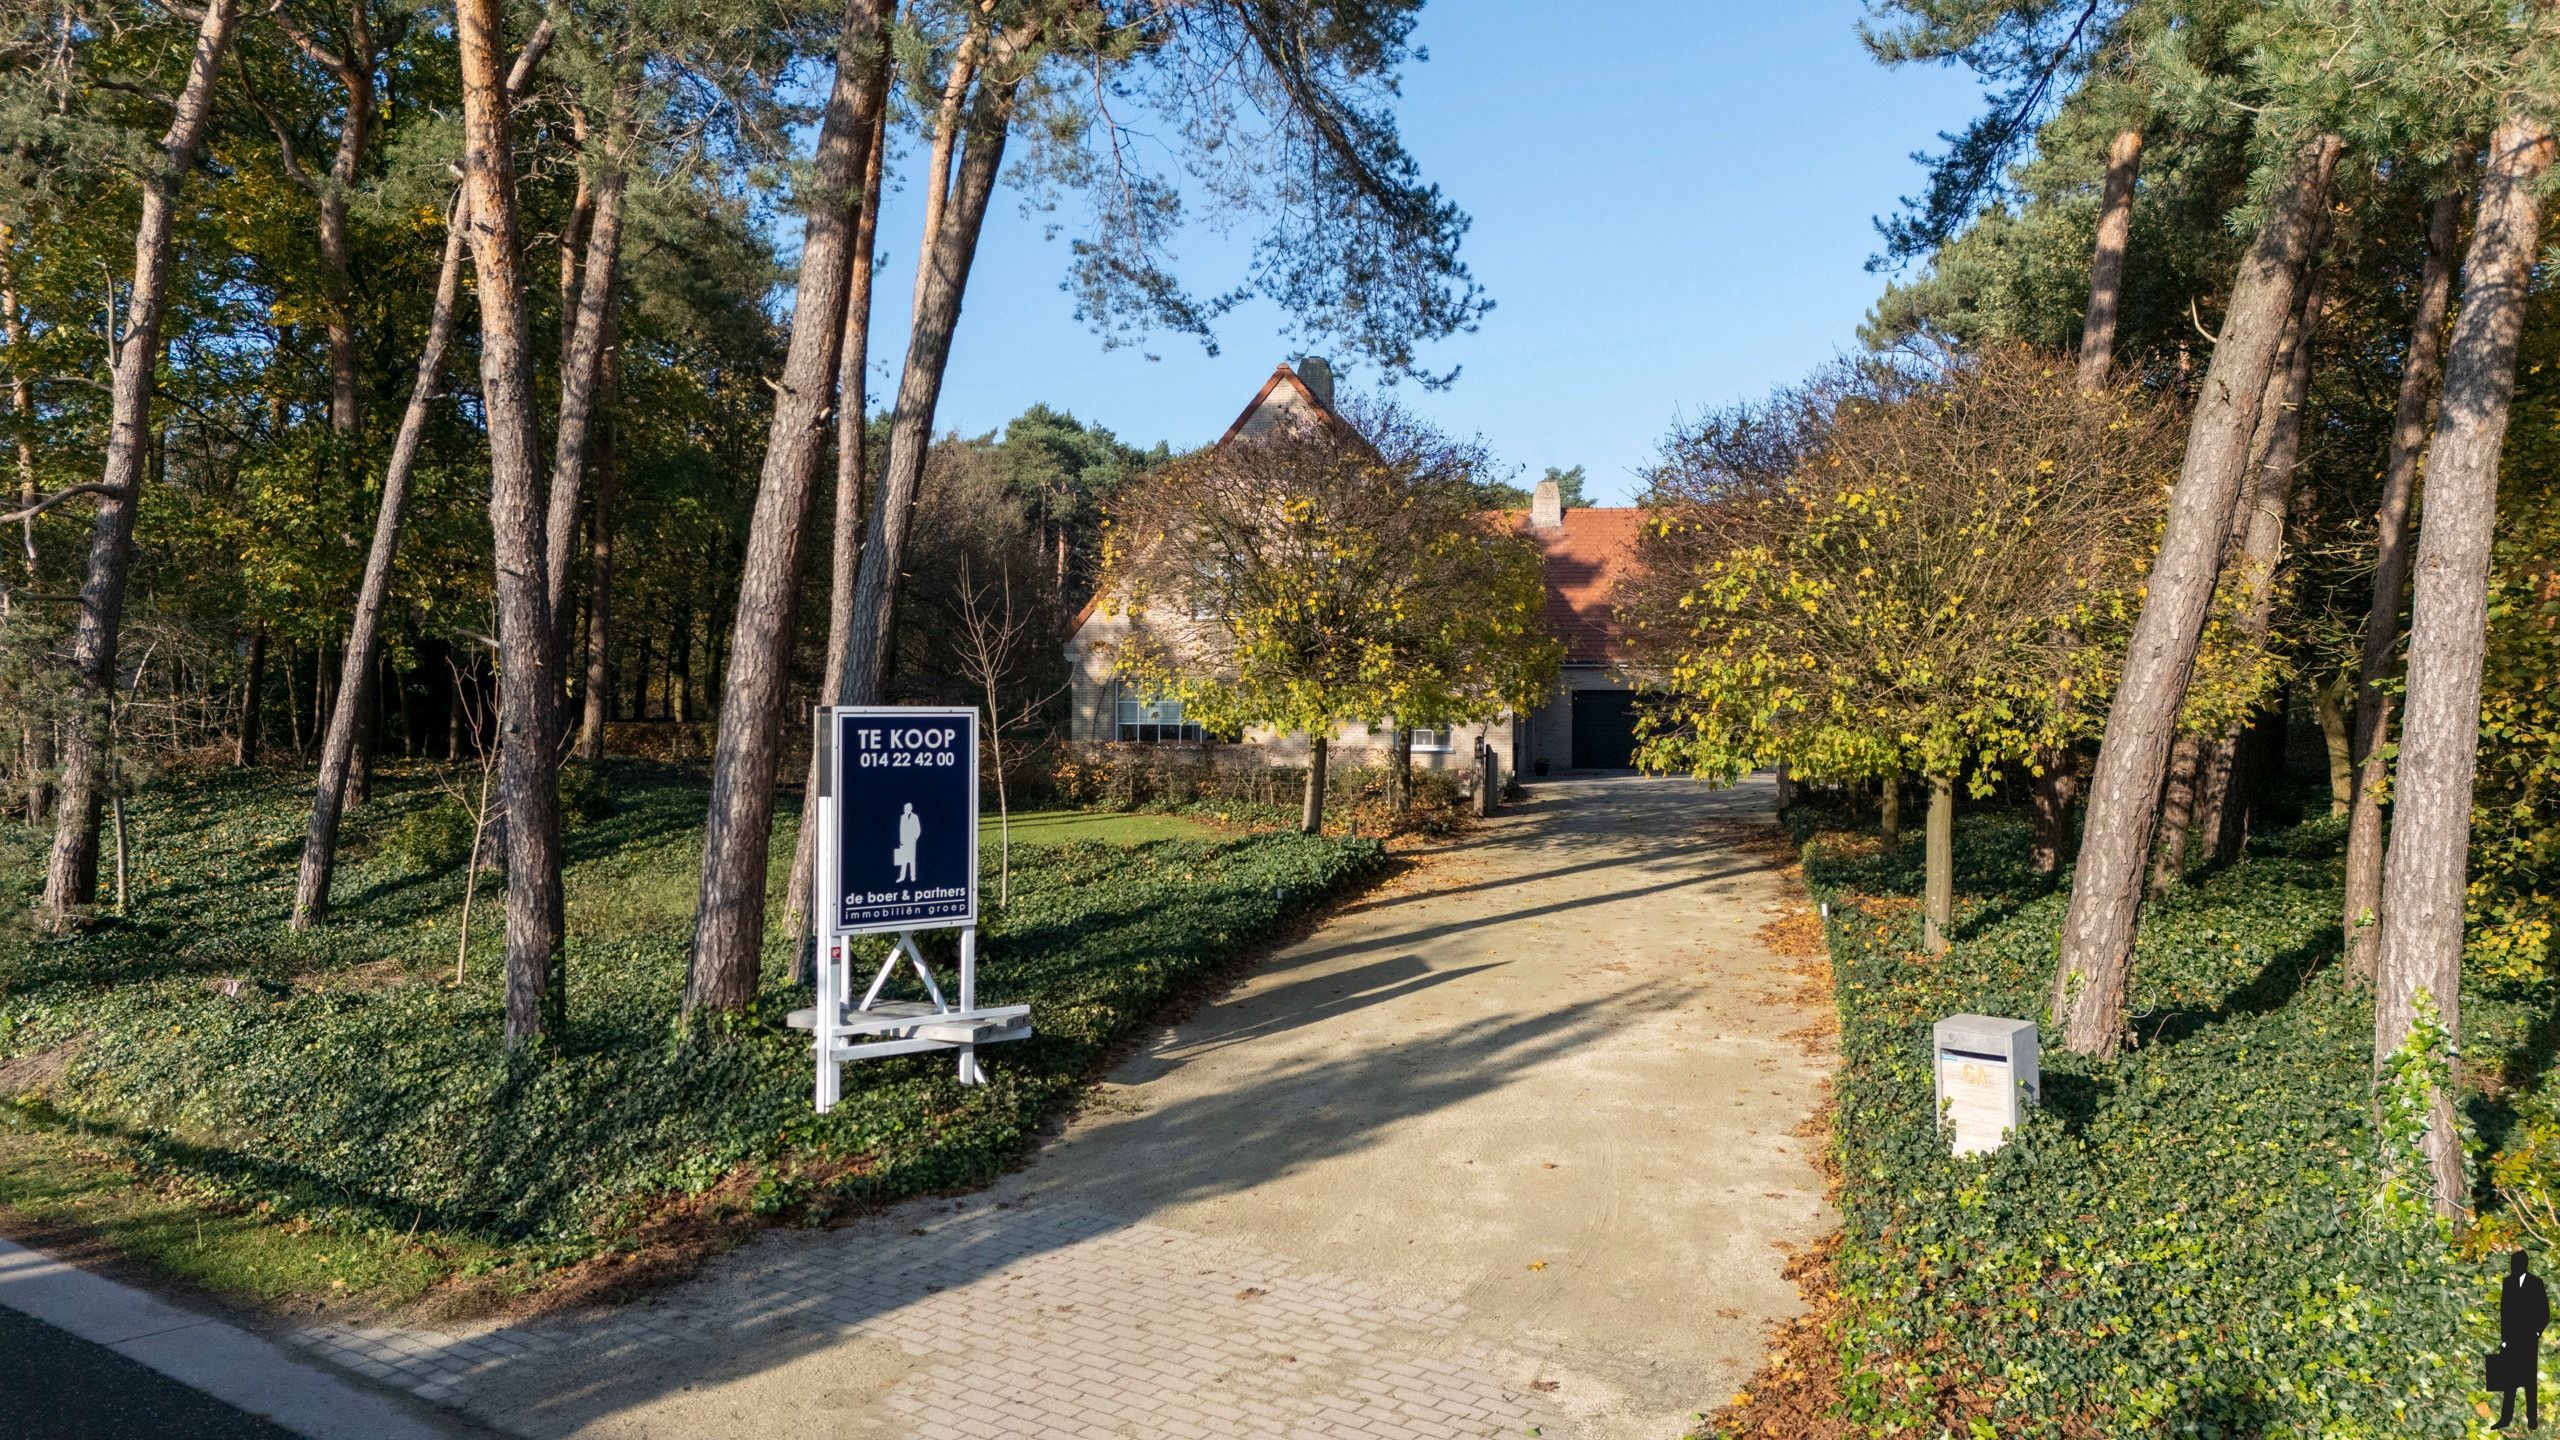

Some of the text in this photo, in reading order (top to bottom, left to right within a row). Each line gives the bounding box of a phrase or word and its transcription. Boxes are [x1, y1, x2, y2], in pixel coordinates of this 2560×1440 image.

[858, 728, 956, 749] TE KOOP
[860, 751, 955, 768] 014 22 42 00
[845, 886, 966, 905] de boer & partners
[845, 903, 966, 920] immobiliën groep
